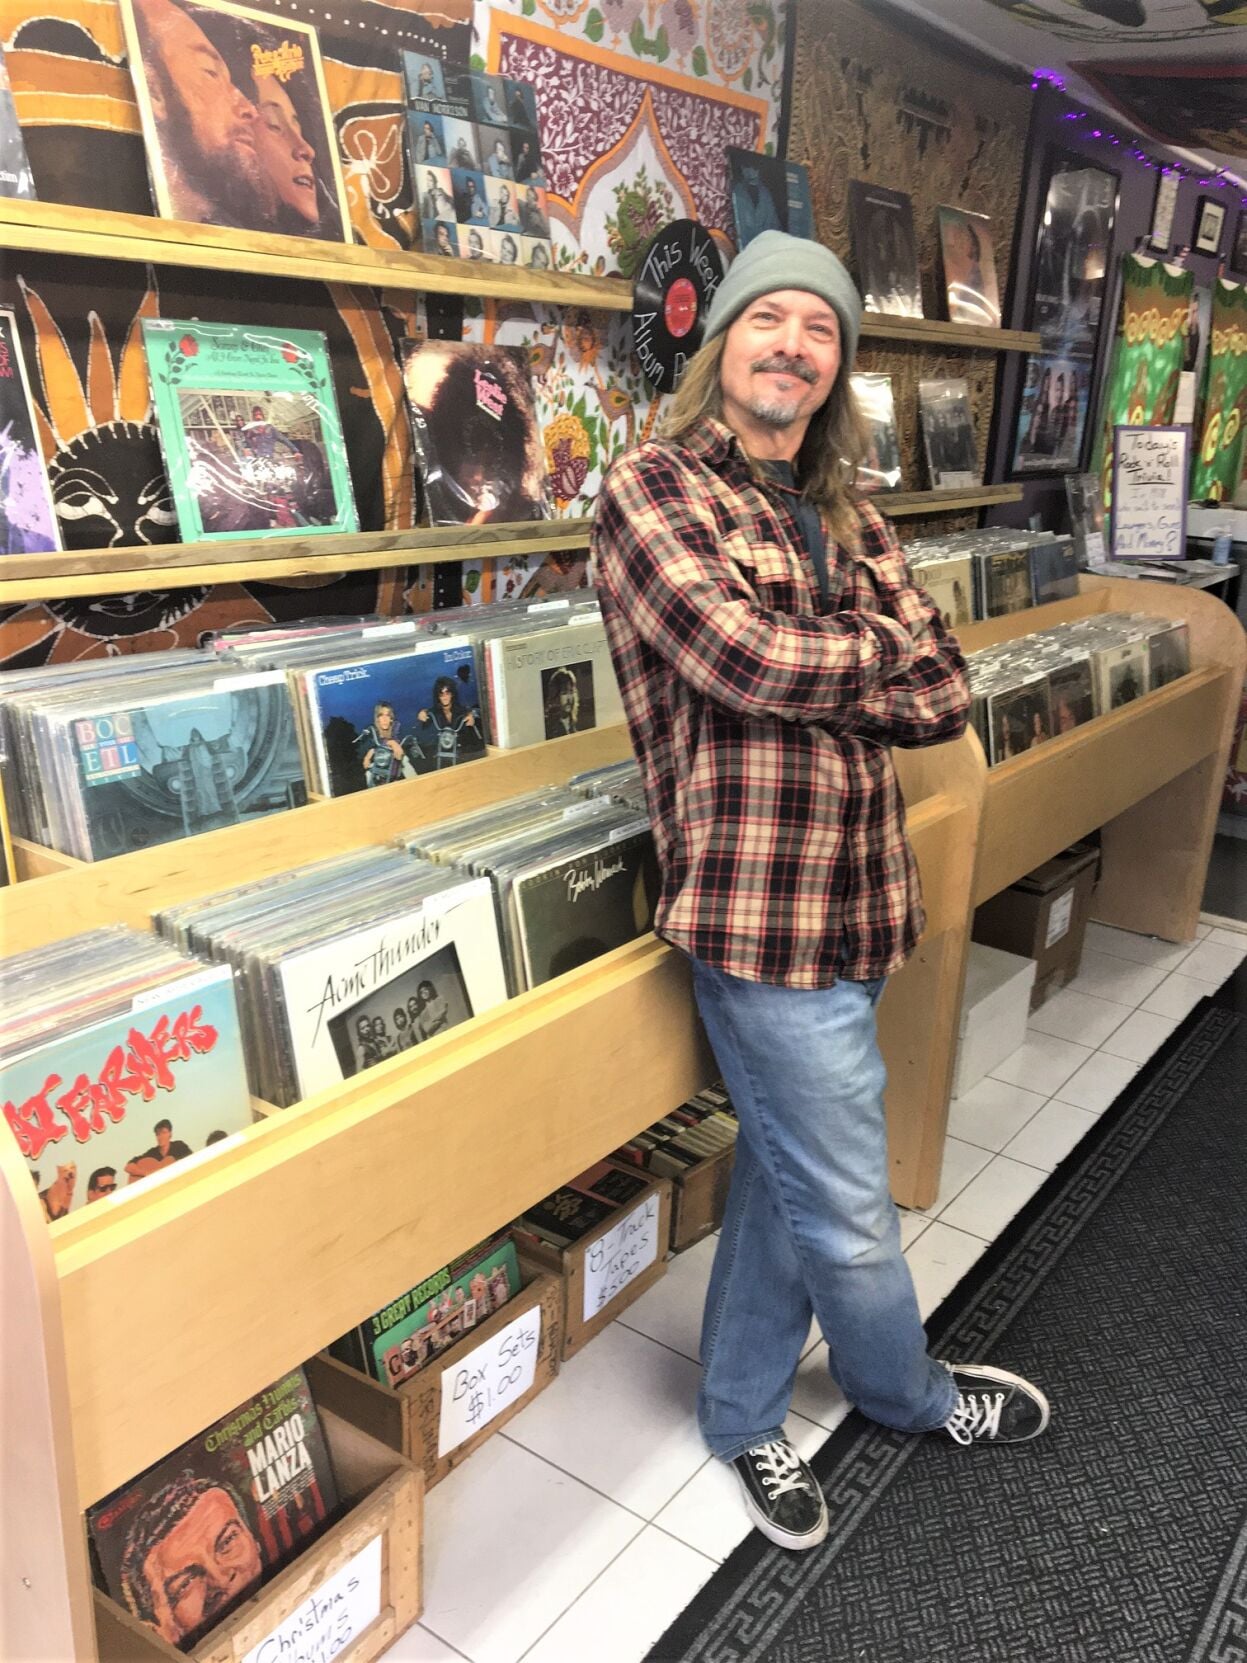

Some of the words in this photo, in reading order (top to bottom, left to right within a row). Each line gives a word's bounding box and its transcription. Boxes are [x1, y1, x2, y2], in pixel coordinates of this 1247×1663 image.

[640, 242, 682, 288] This
[633, 311, 665, 387] Album
[318, 673, 344, 686] Cheap
[306, 974, 367, 1049] Acme
[354, 914, 442, 985] Thunder
[55, 1004, 219, 1144] FARMERS
[371, 1316, 382, 1336] 3
[379, 1293, 412, 1330] GREAT
[411, 1265, 451, 1310] RECORDS
[452, 1362, 489, 1402] Box
[498, 1328, 537, 1368] Sets
[465, 1365, 523, 1425] $1.00
[246, 1413, 305, 1477] MARIO
[254, 1440, 314, 1503] LANZA
[256, 1576, 360, 1663] Christmas
